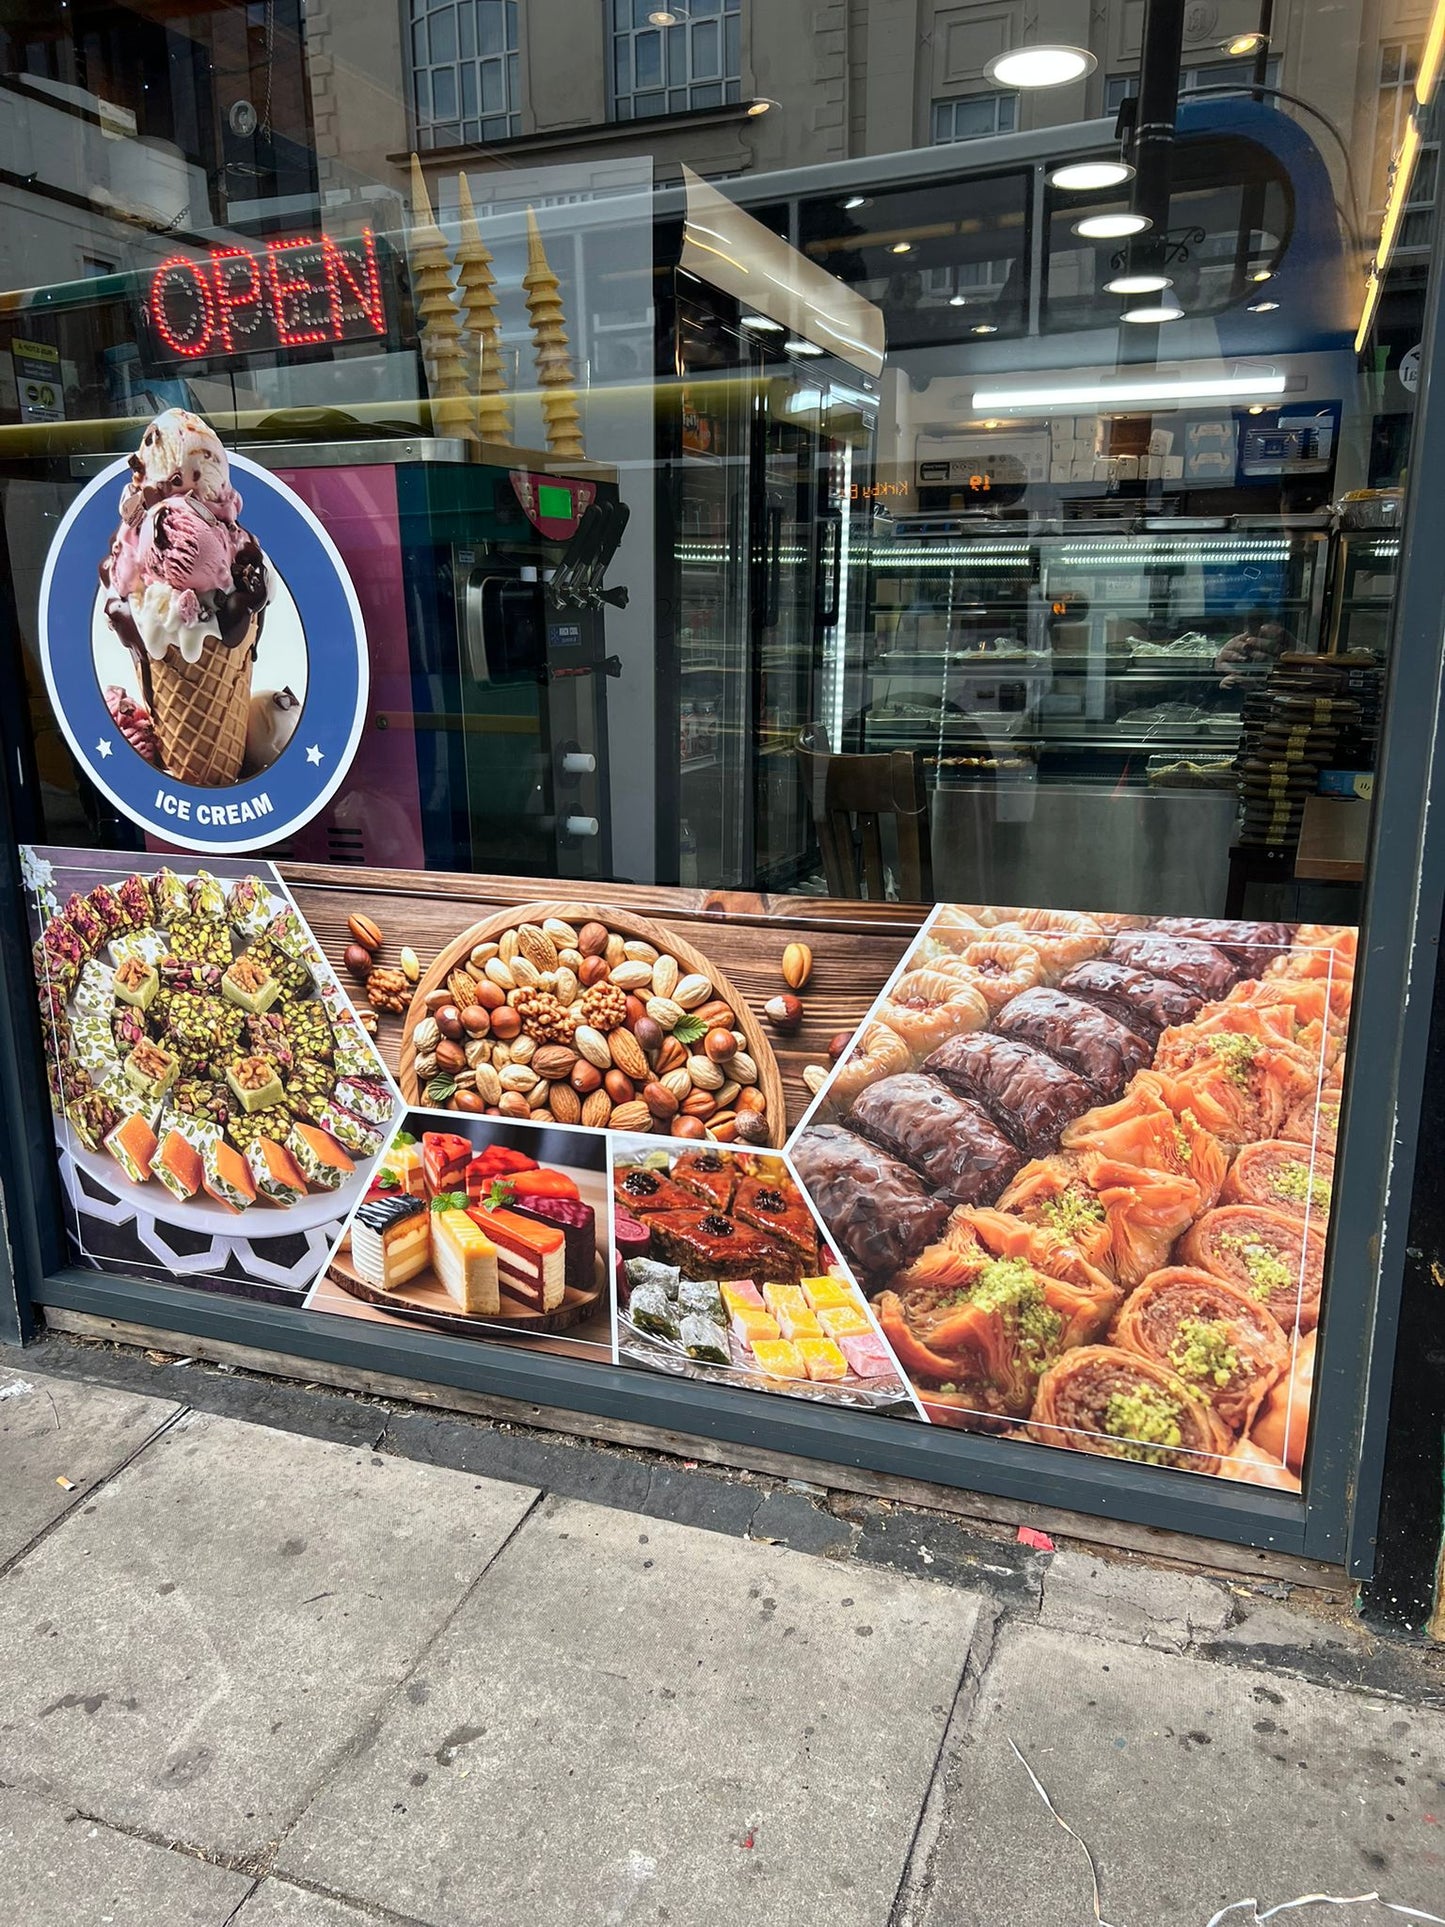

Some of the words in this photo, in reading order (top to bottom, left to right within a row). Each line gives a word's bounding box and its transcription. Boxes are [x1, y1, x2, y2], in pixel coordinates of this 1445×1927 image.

[151, 227, 387, 357] OPEN
[154, 789, 191, 821] ICE
[196, 792, 274, 825] CREAM
